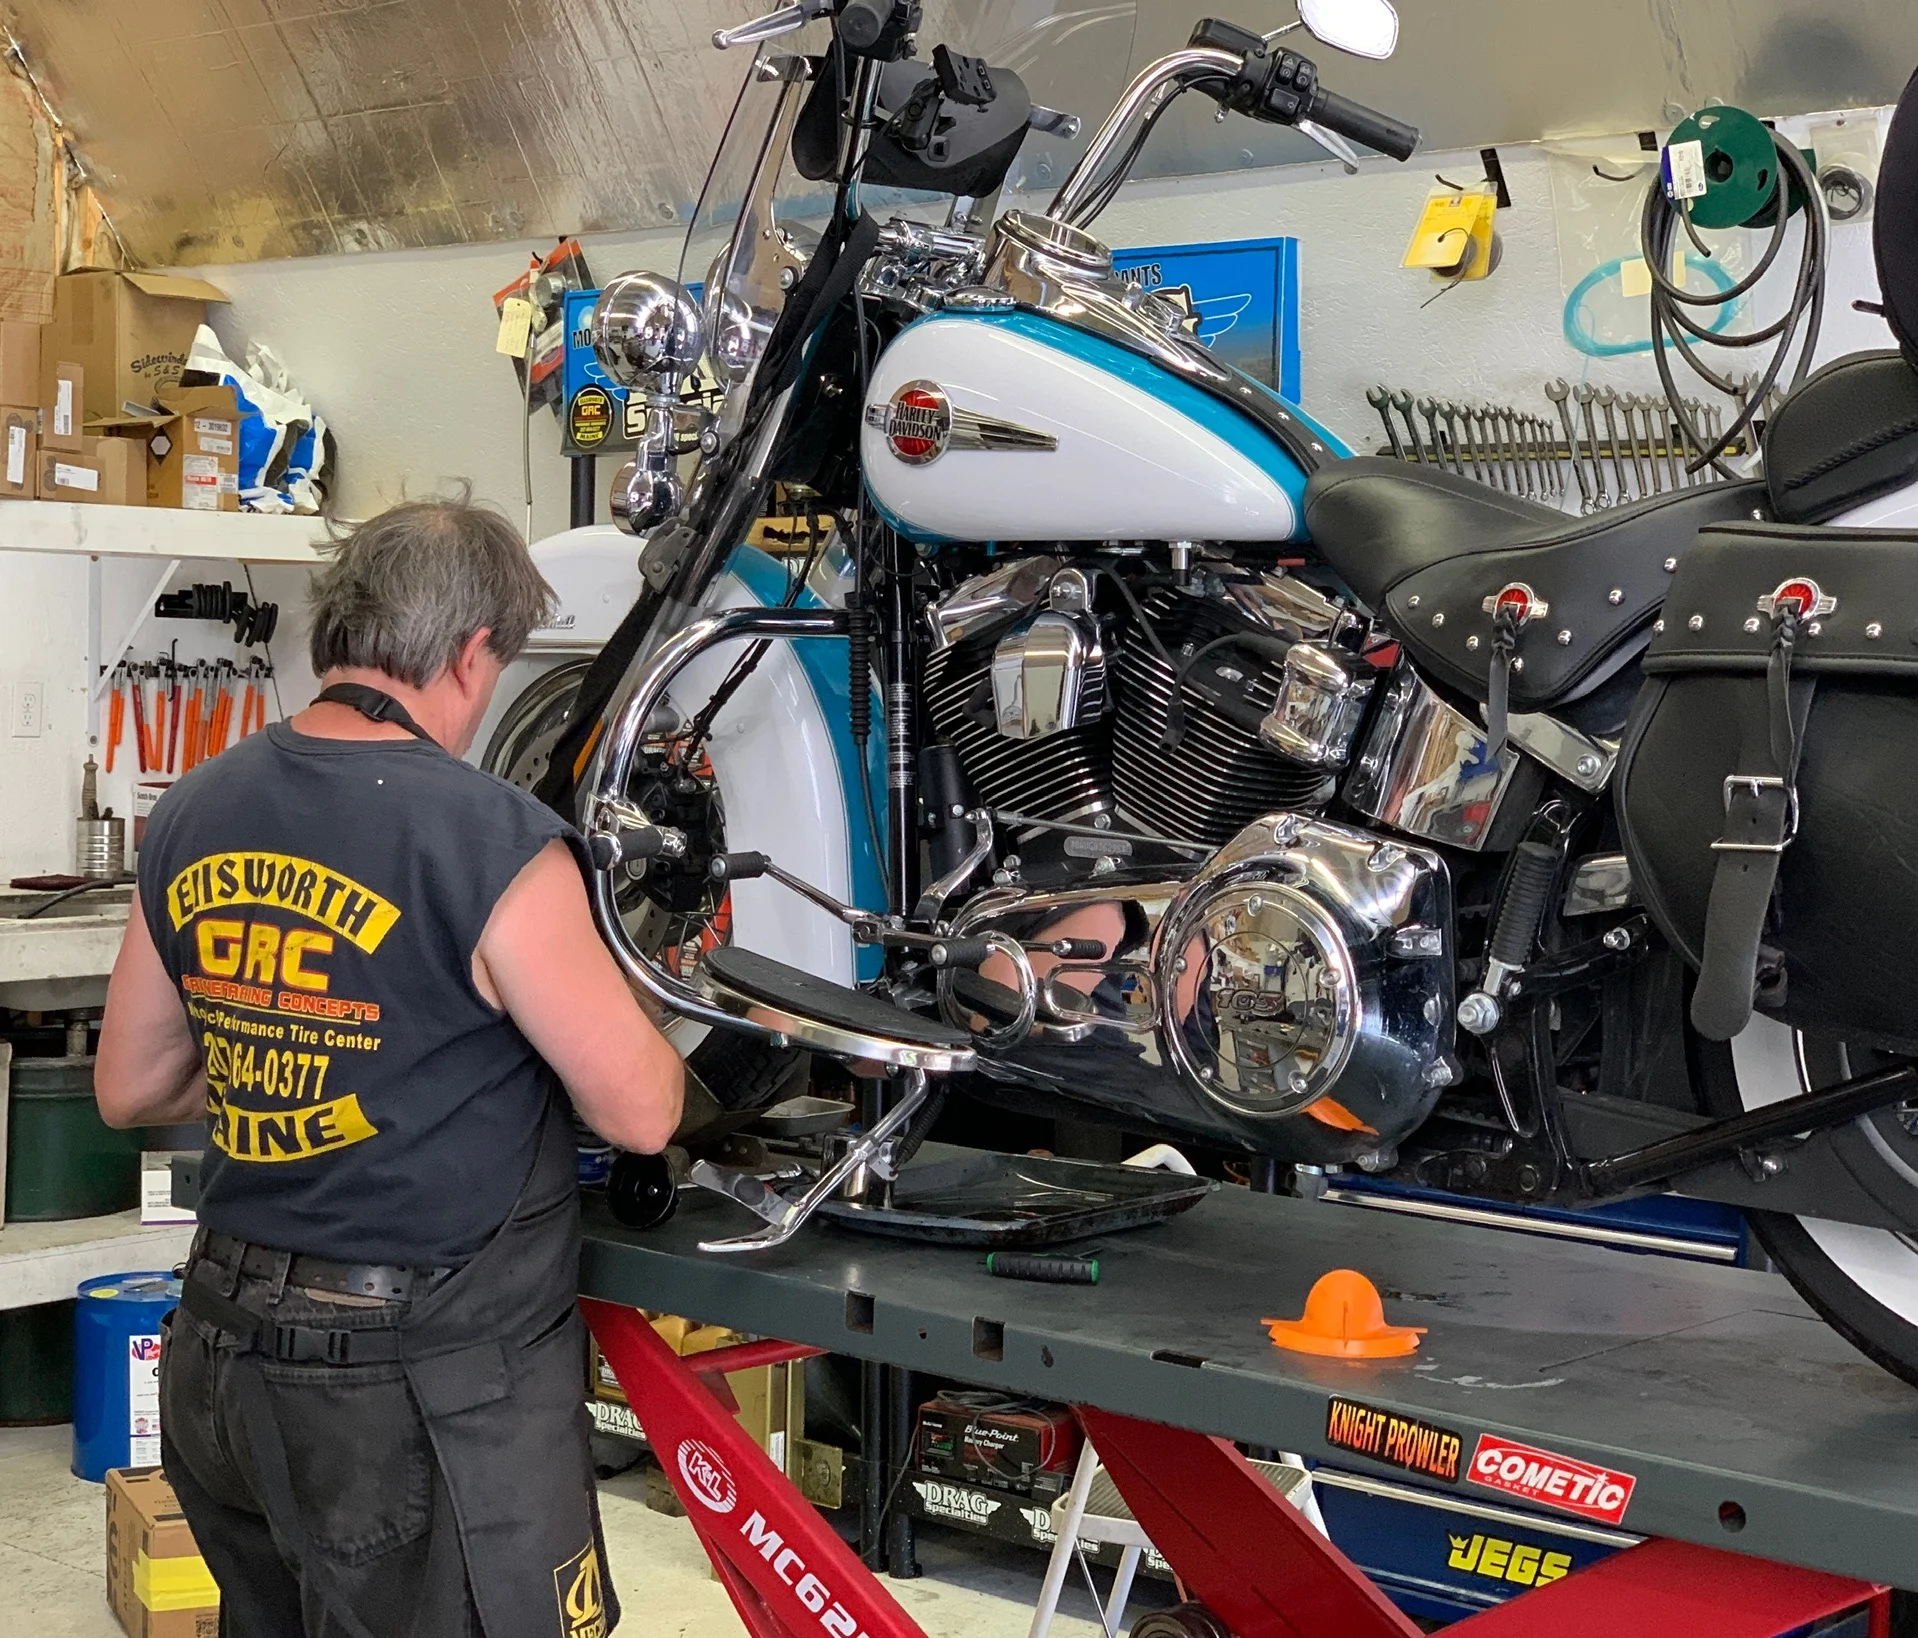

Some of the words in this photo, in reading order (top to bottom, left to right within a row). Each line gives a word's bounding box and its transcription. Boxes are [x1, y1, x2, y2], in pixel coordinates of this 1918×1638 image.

[130, 351, 188, 373] Sidewinde
[889, 419, 941, 441] DAVIDSON
[195, 918, 334, 993] GRC
[278, 990, 380, 1022] CONCEPTS
[290, 1024, 319, 1045] Tire
[324, 1029, 381, 1051] Center
[963, 1435, 983, 1447] Battry
[983, 1438, 1004, 1451] Charger
[964, 1424, 1018, 1443] Bue-Point
[1328, 1400, 1387, 1454] KNIGHT
[1384, 1418, 1460, 1478] PROWLER
[1476, 1449, 1625, 1511] COMETIC
[1484, 1475, 1540, 1497] GASKET
[924, 1501, 988, 1524] Specialties
[926, 1481, 988, 1515] DRAG
[739, 1509, 870, 1638] MC62
[1448, 1534, 1573, 1587] JEGS
